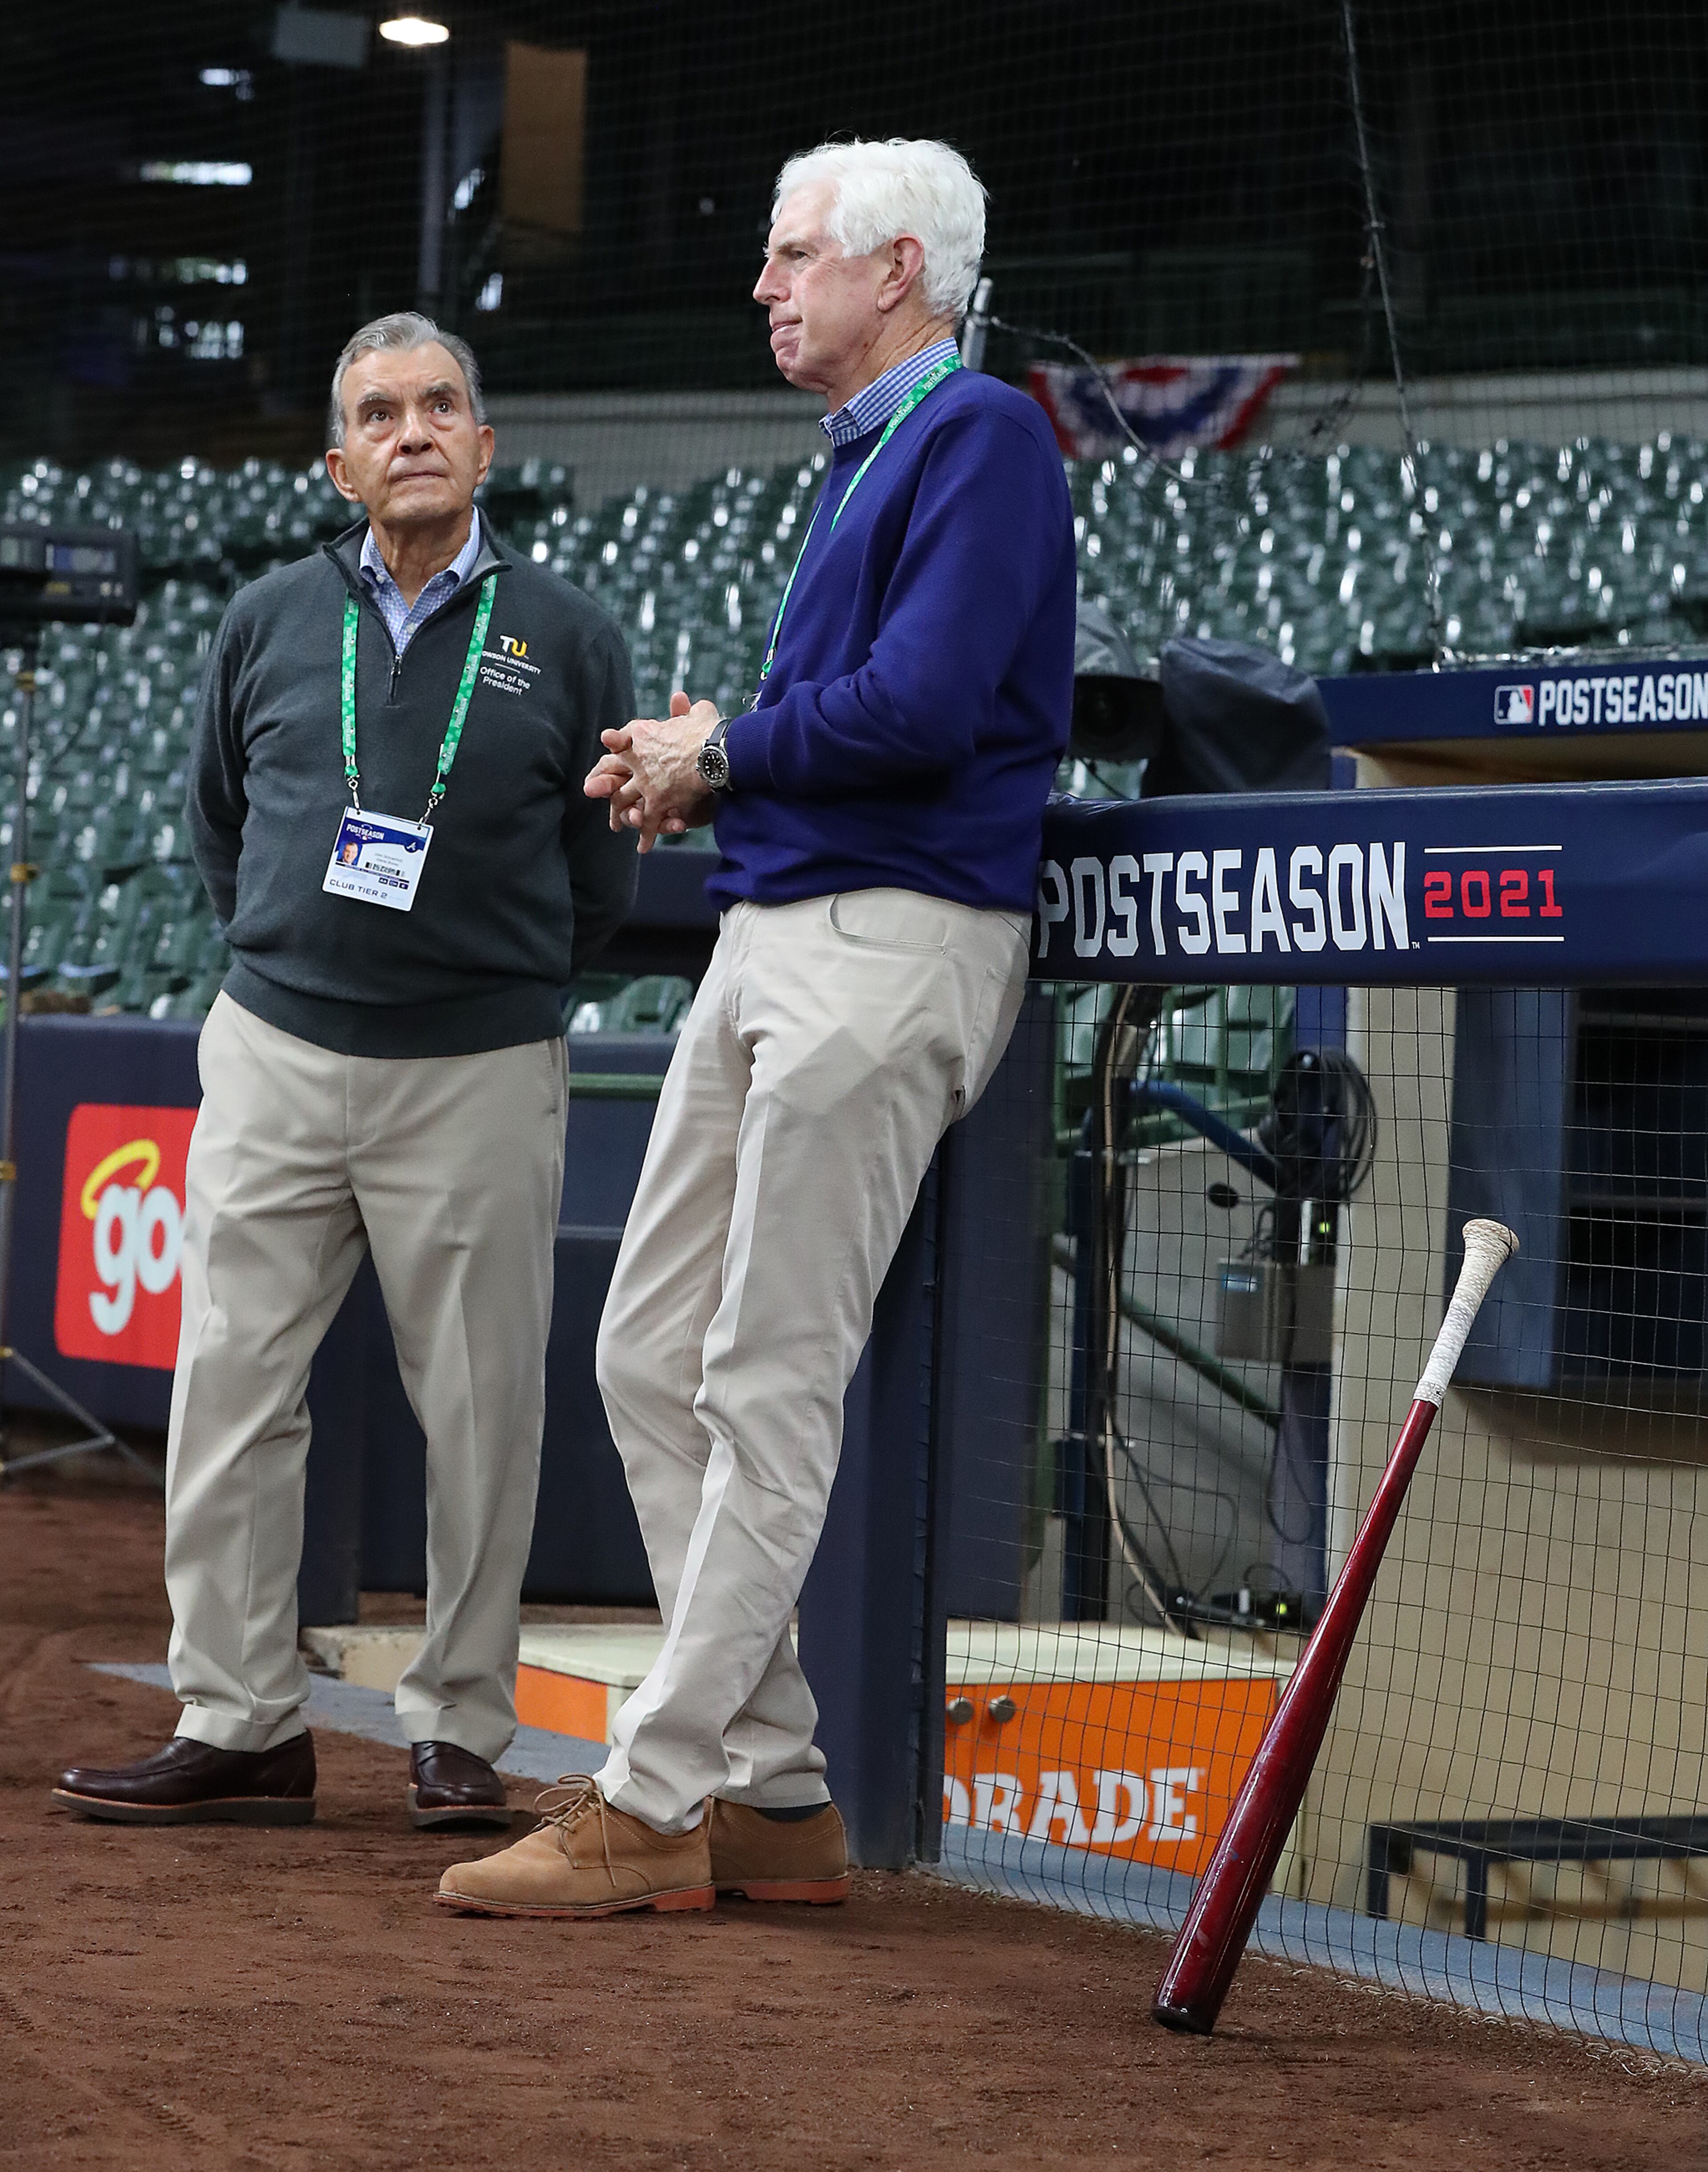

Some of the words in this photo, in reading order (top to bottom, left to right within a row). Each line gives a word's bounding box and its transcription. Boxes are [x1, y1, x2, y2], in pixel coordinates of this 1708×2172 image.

[482, 650, 506, 662] OWSON
[500, 635, 527, 657] TU
[480, 666, 506, 680] Office
[507, 675, 517, 683] of
[517, 678, 531, 689] the
[482, 676, 523, 695] President
[1538, 672, 1708, 726] POSTSEASON
[346, 824, 385, 840] POSTSEASON
[329, 879, 355, 891] CLUB
[358, 886, 379, 896] TIER
[1037, 842, 1410, 958] POSTSEASON
[1424, 870, 1563, 918] 2021
[89, 1184, 184, 1335] go
